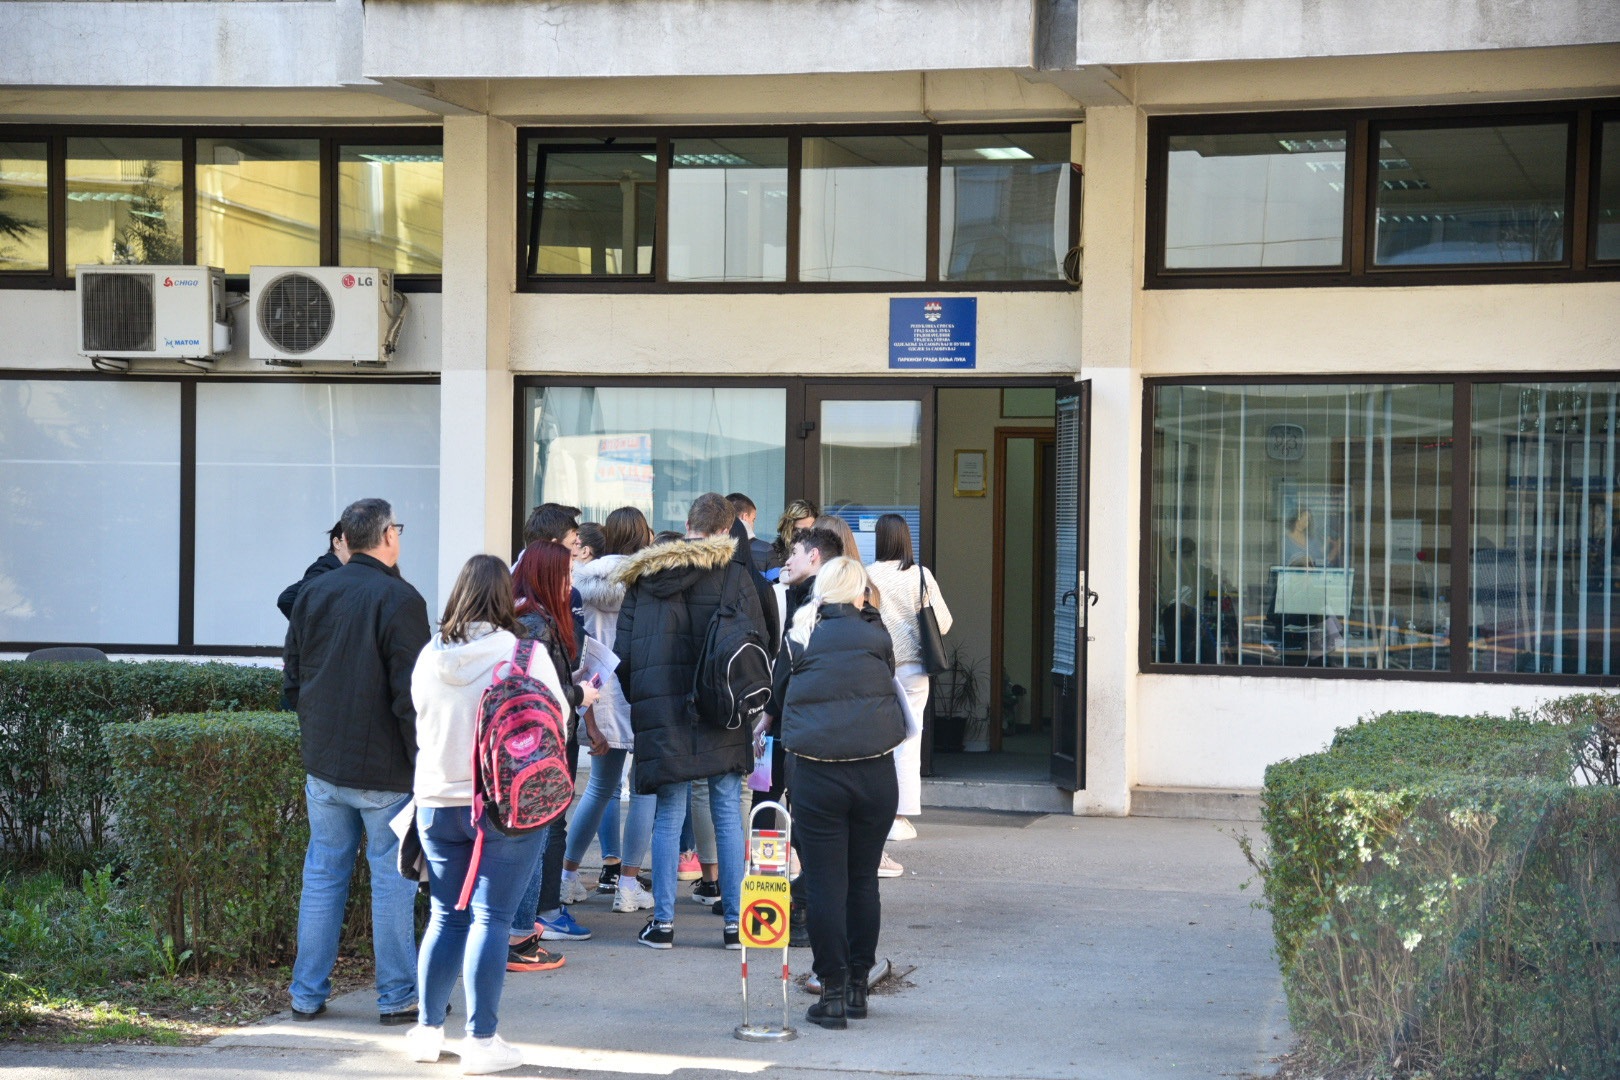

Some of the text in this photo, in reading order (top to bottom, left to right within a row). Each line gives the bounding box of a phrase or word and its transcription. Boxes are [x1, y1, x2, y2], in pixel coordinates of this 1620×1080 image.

[358, 277, 373, 287] LG
[744, 881, 787, 892] NO PARKING
[752, 906, 777, 936] P
